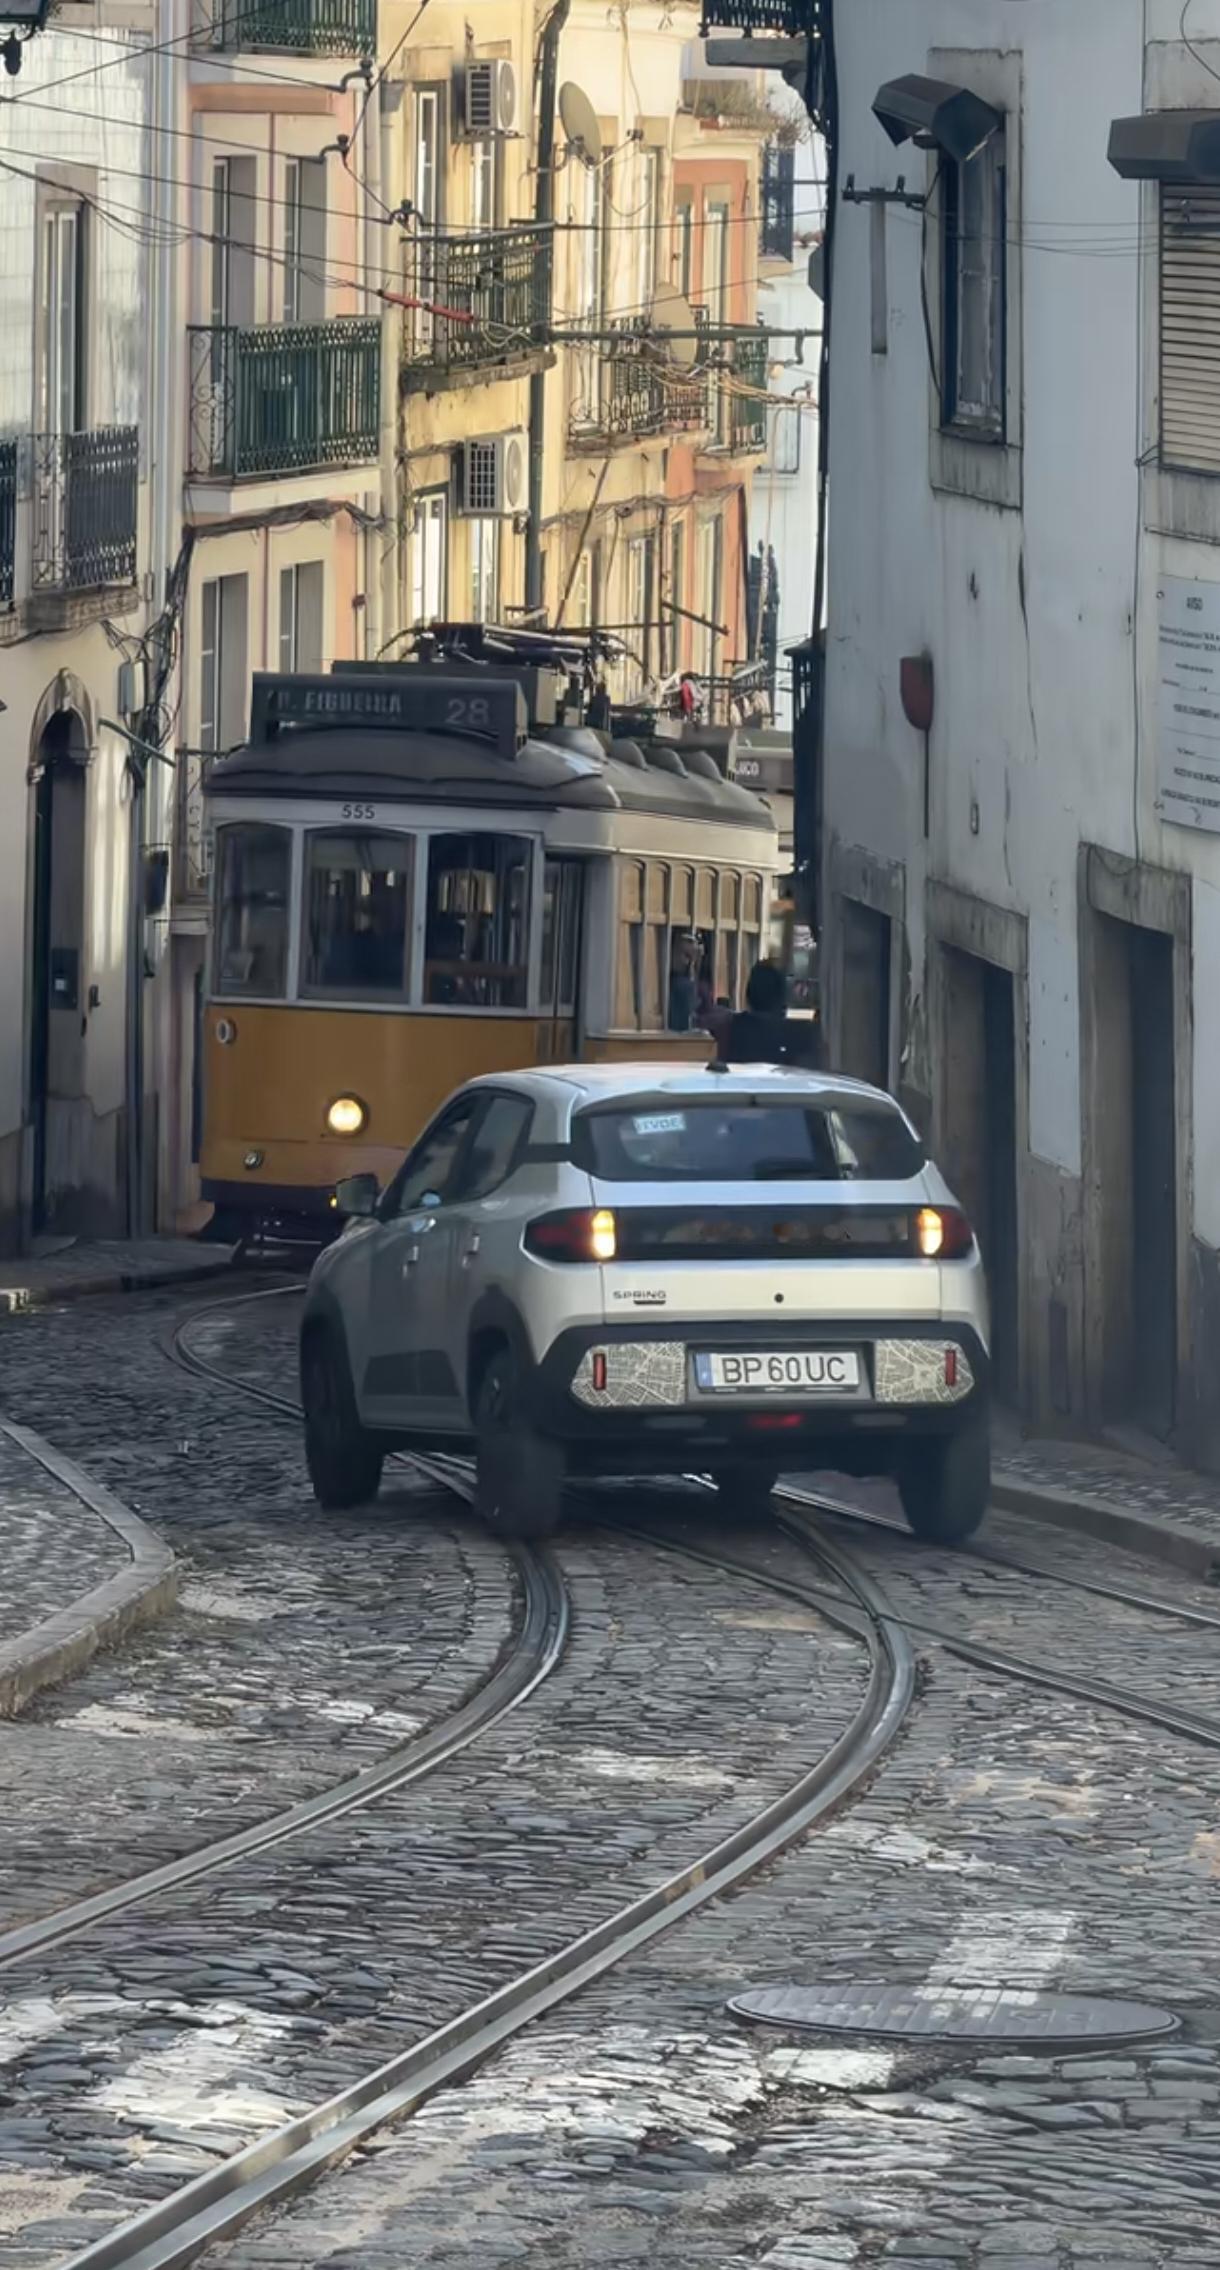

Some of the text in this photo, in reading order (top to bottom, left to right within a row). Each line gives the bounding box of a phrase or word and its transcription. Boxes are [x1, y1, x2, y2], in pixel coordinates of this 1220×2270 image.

[444, 697, 489, 725] 28
[341, 804, 376, 820] 555
[613, 1290, 667, 1300] SPRING
